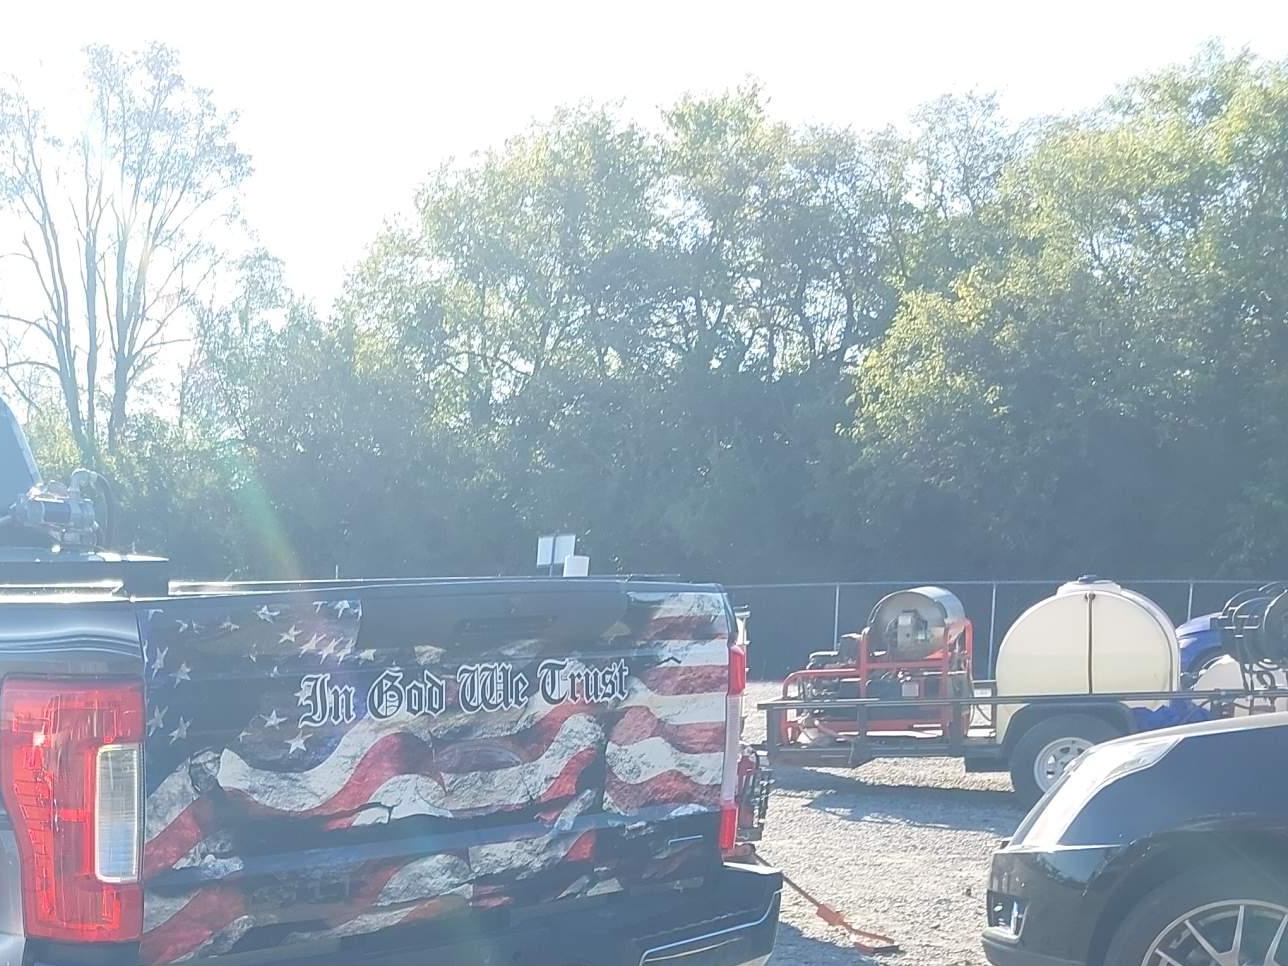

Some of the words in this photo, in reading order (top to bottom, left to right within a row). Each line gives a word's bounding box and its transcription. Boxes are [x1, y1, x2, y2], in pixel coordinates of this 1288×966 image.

[298, 673, 356, 728] In
[367, 664, 446, 720] God
[457, 661, 530, 714] We
[537, 658, 629, 706] Trust
